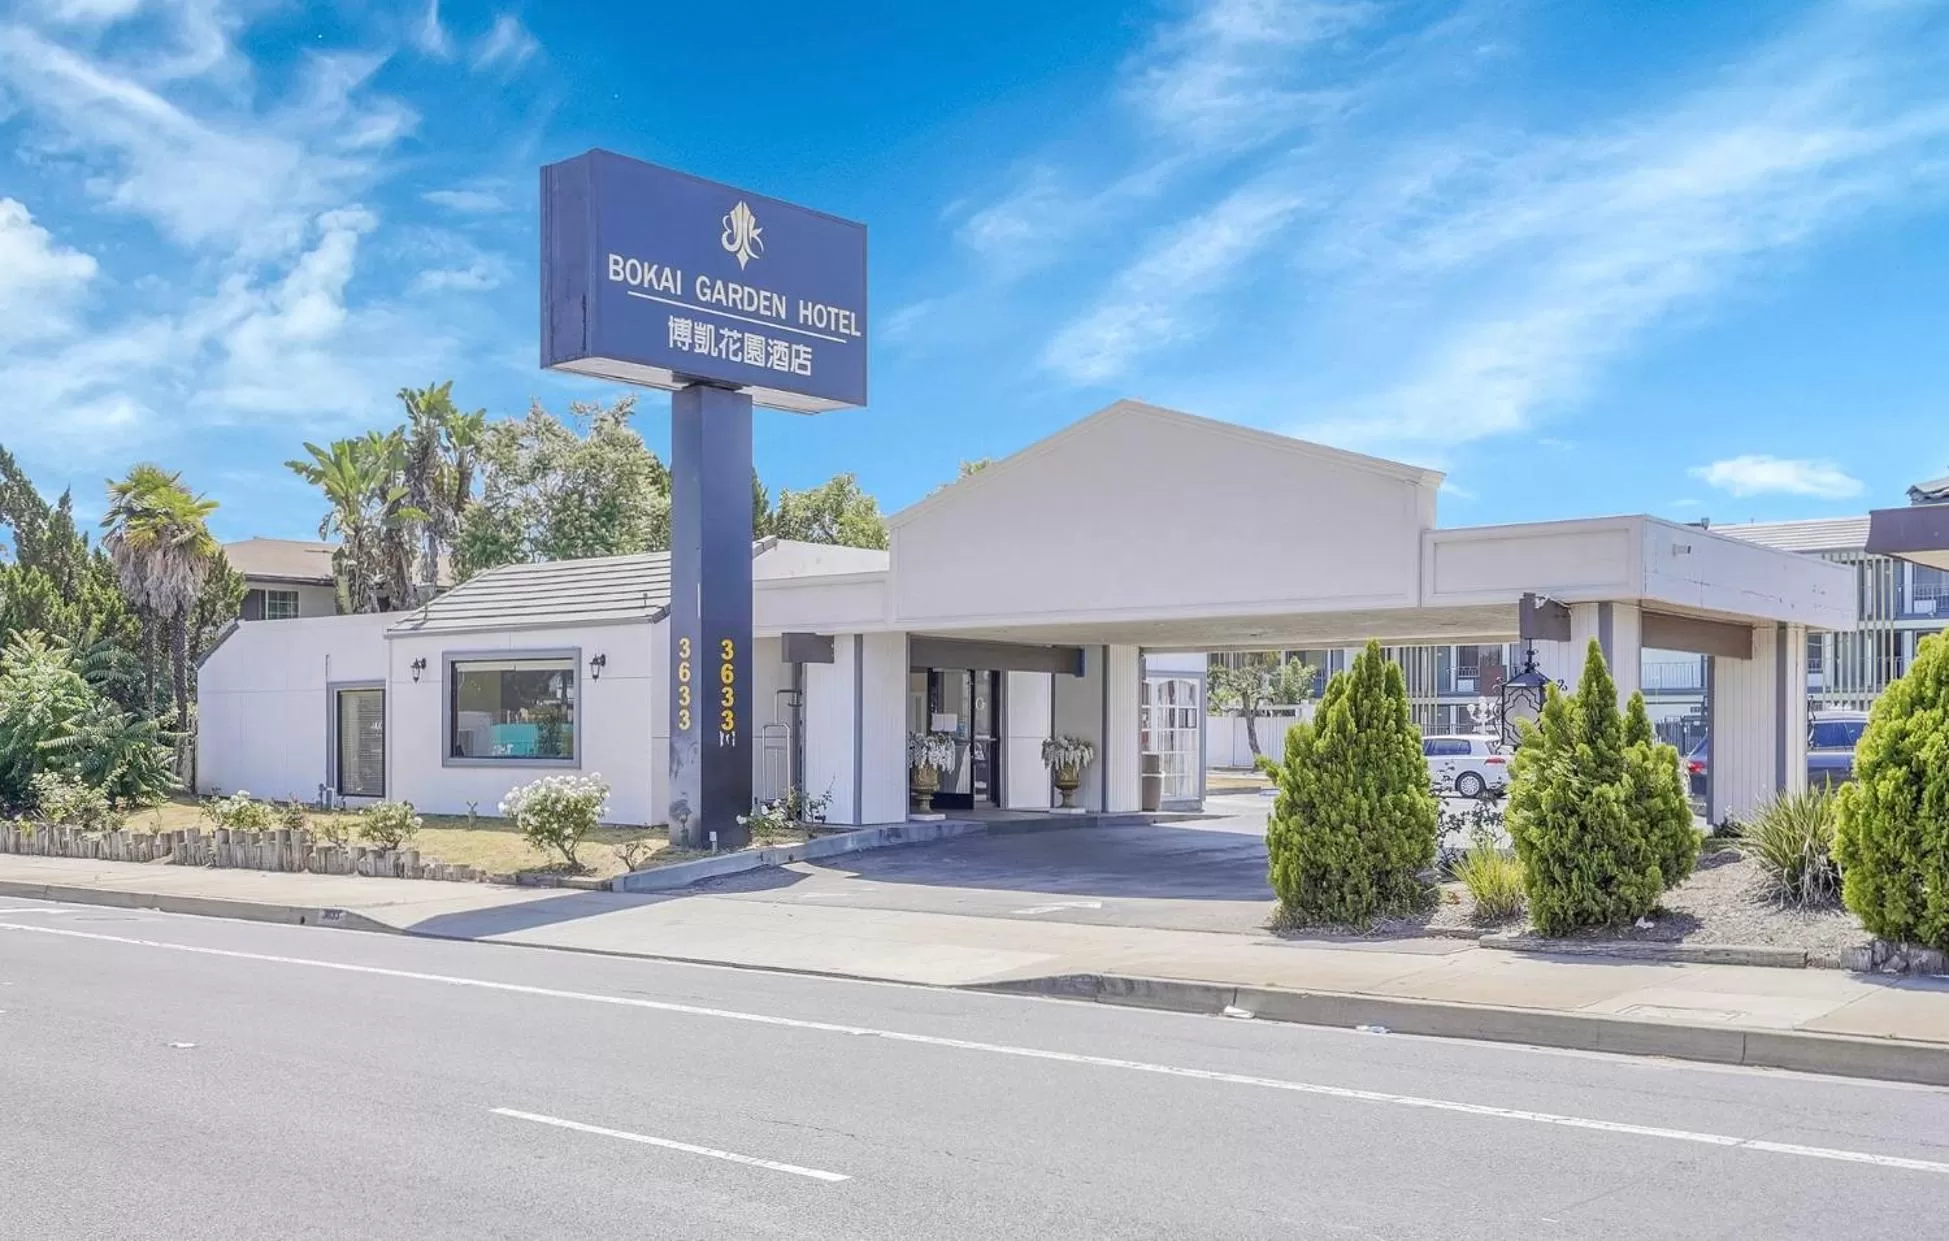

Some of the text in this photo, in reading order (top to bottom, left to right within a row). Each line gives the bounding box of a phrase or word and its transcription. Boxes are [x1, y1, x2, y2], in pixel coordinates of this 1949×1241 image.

[608, 254, 861, 337] BOKAI GARDEN HOTEL
[667, 315, 812, 376] 博凱花園酒店
[679, 638, 691, 730] 3633
[721, 639, 734, 731] 3633
